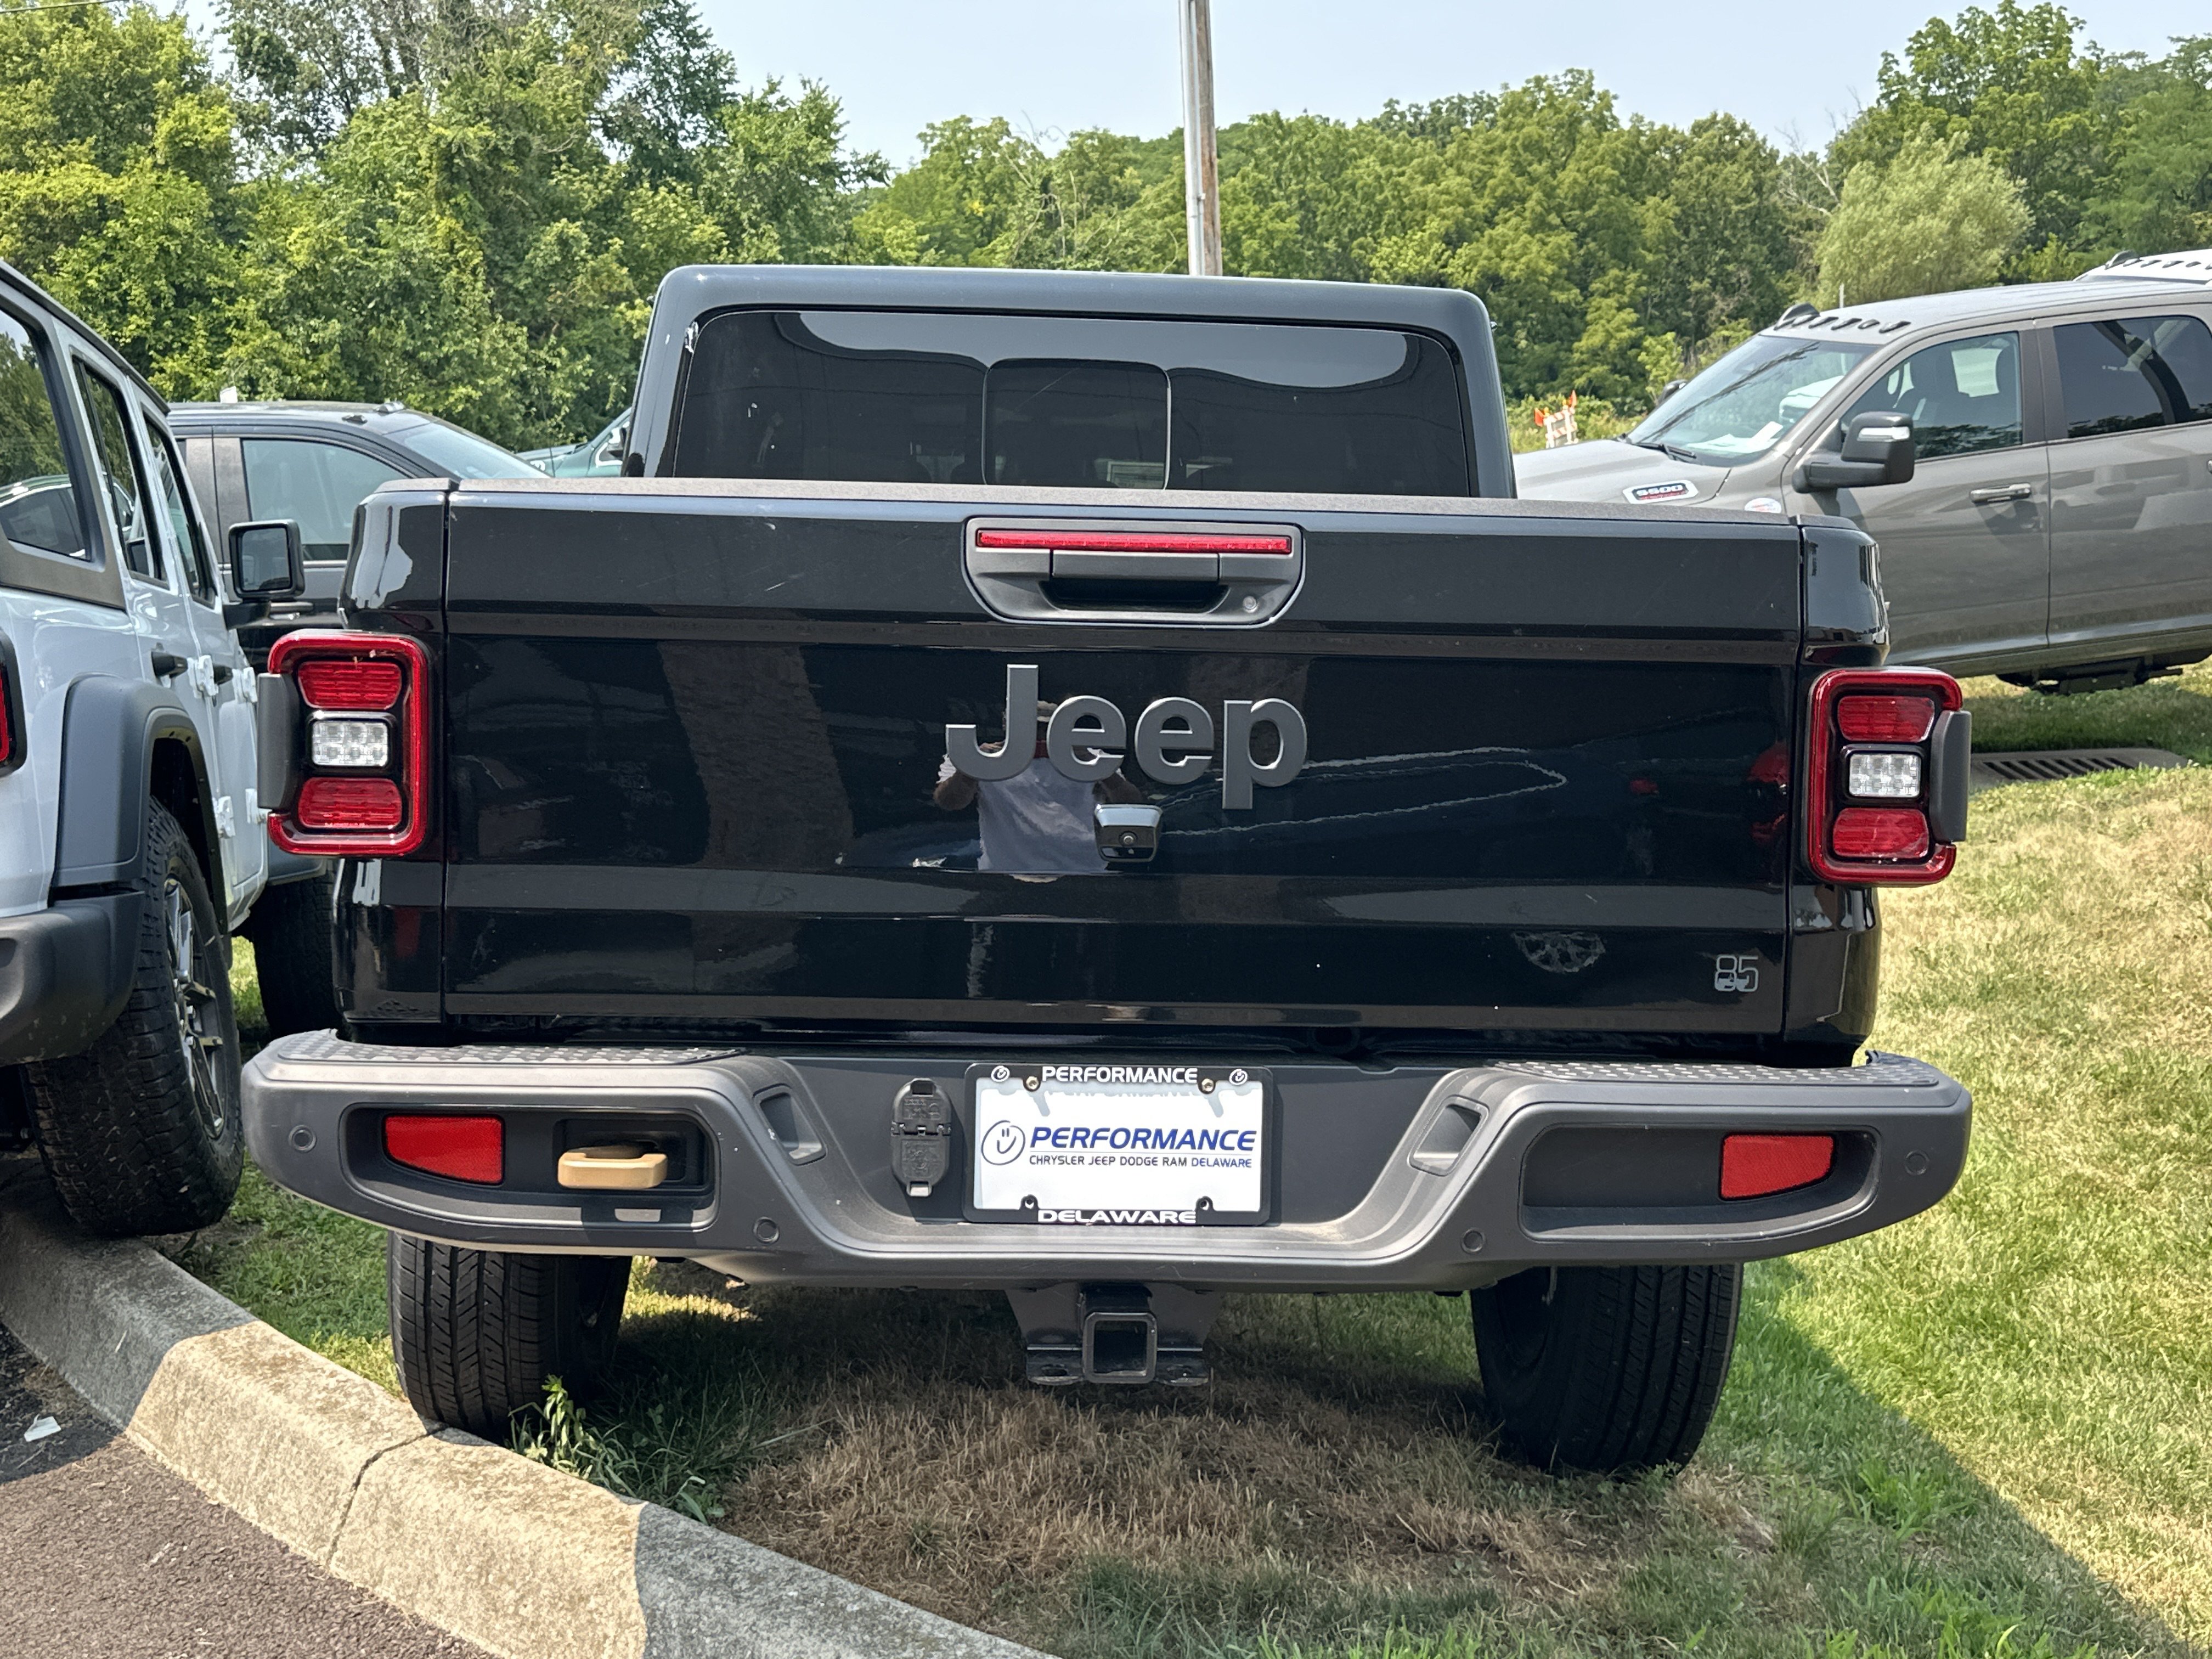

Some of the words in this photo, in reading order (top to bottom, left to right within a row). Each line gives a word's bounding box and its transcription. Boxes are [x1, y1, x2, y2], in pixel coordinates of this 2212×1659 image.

[945, 664, 1307, 809] Jeep
[1714, 955, 1759, 992] 85
[1042, 1066, 1198, 1084] PERFORMANCE
[1030, 1126, 1257, 1152] PERFORMANCE
[1029, 1155, 1085, 1166] CHRYSLER
[1088, 1155, 1116, 1166] JEEP
[1120, 1156, 1158, 1167] DODGE
[1162, 1156, 1187, 1167] RAM
[1191, 1157, 1252, 1169] DELAWARE
[1038, 1210, 1197, 1224] DELAWARE
